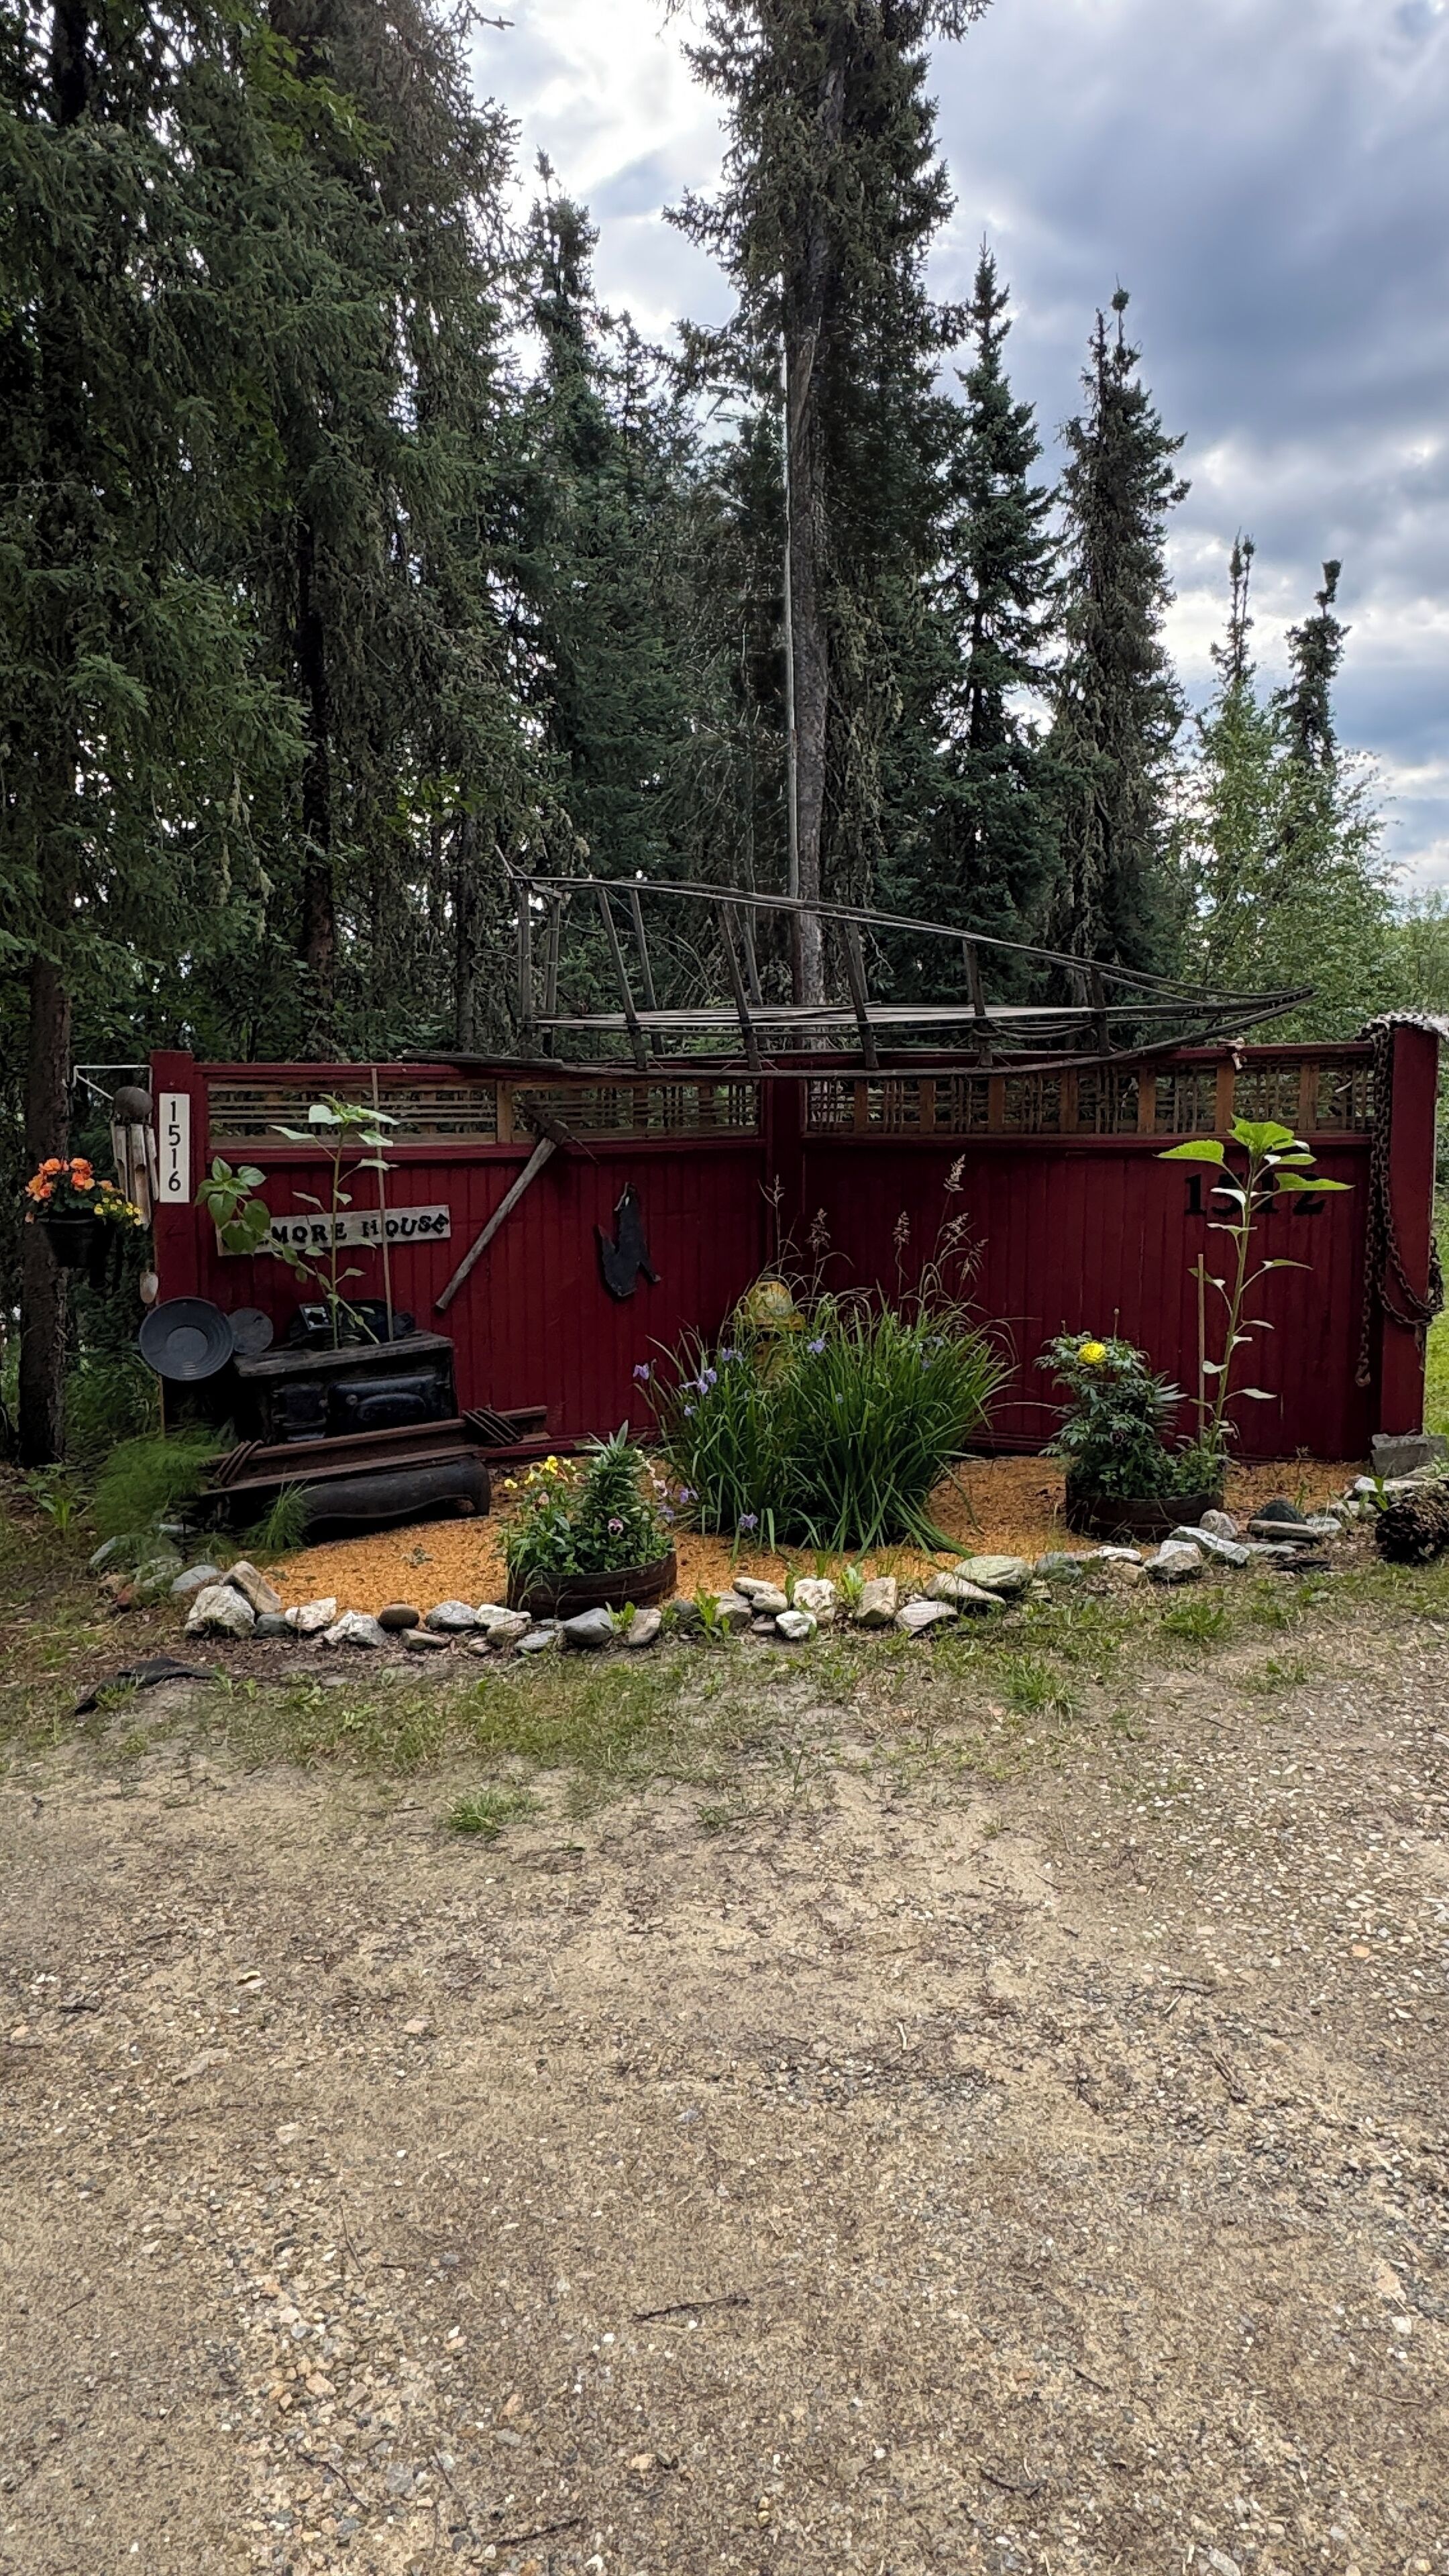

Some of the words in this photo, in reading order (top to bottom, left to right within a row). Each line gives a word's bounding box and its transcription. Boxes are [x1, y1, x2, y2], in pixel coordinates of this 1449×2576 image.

[168, 1100, 181, 1192] 1516
[1184, 1172, 1327, 1216] 1512
[362, 1214, 449, 1237] HOUSE
